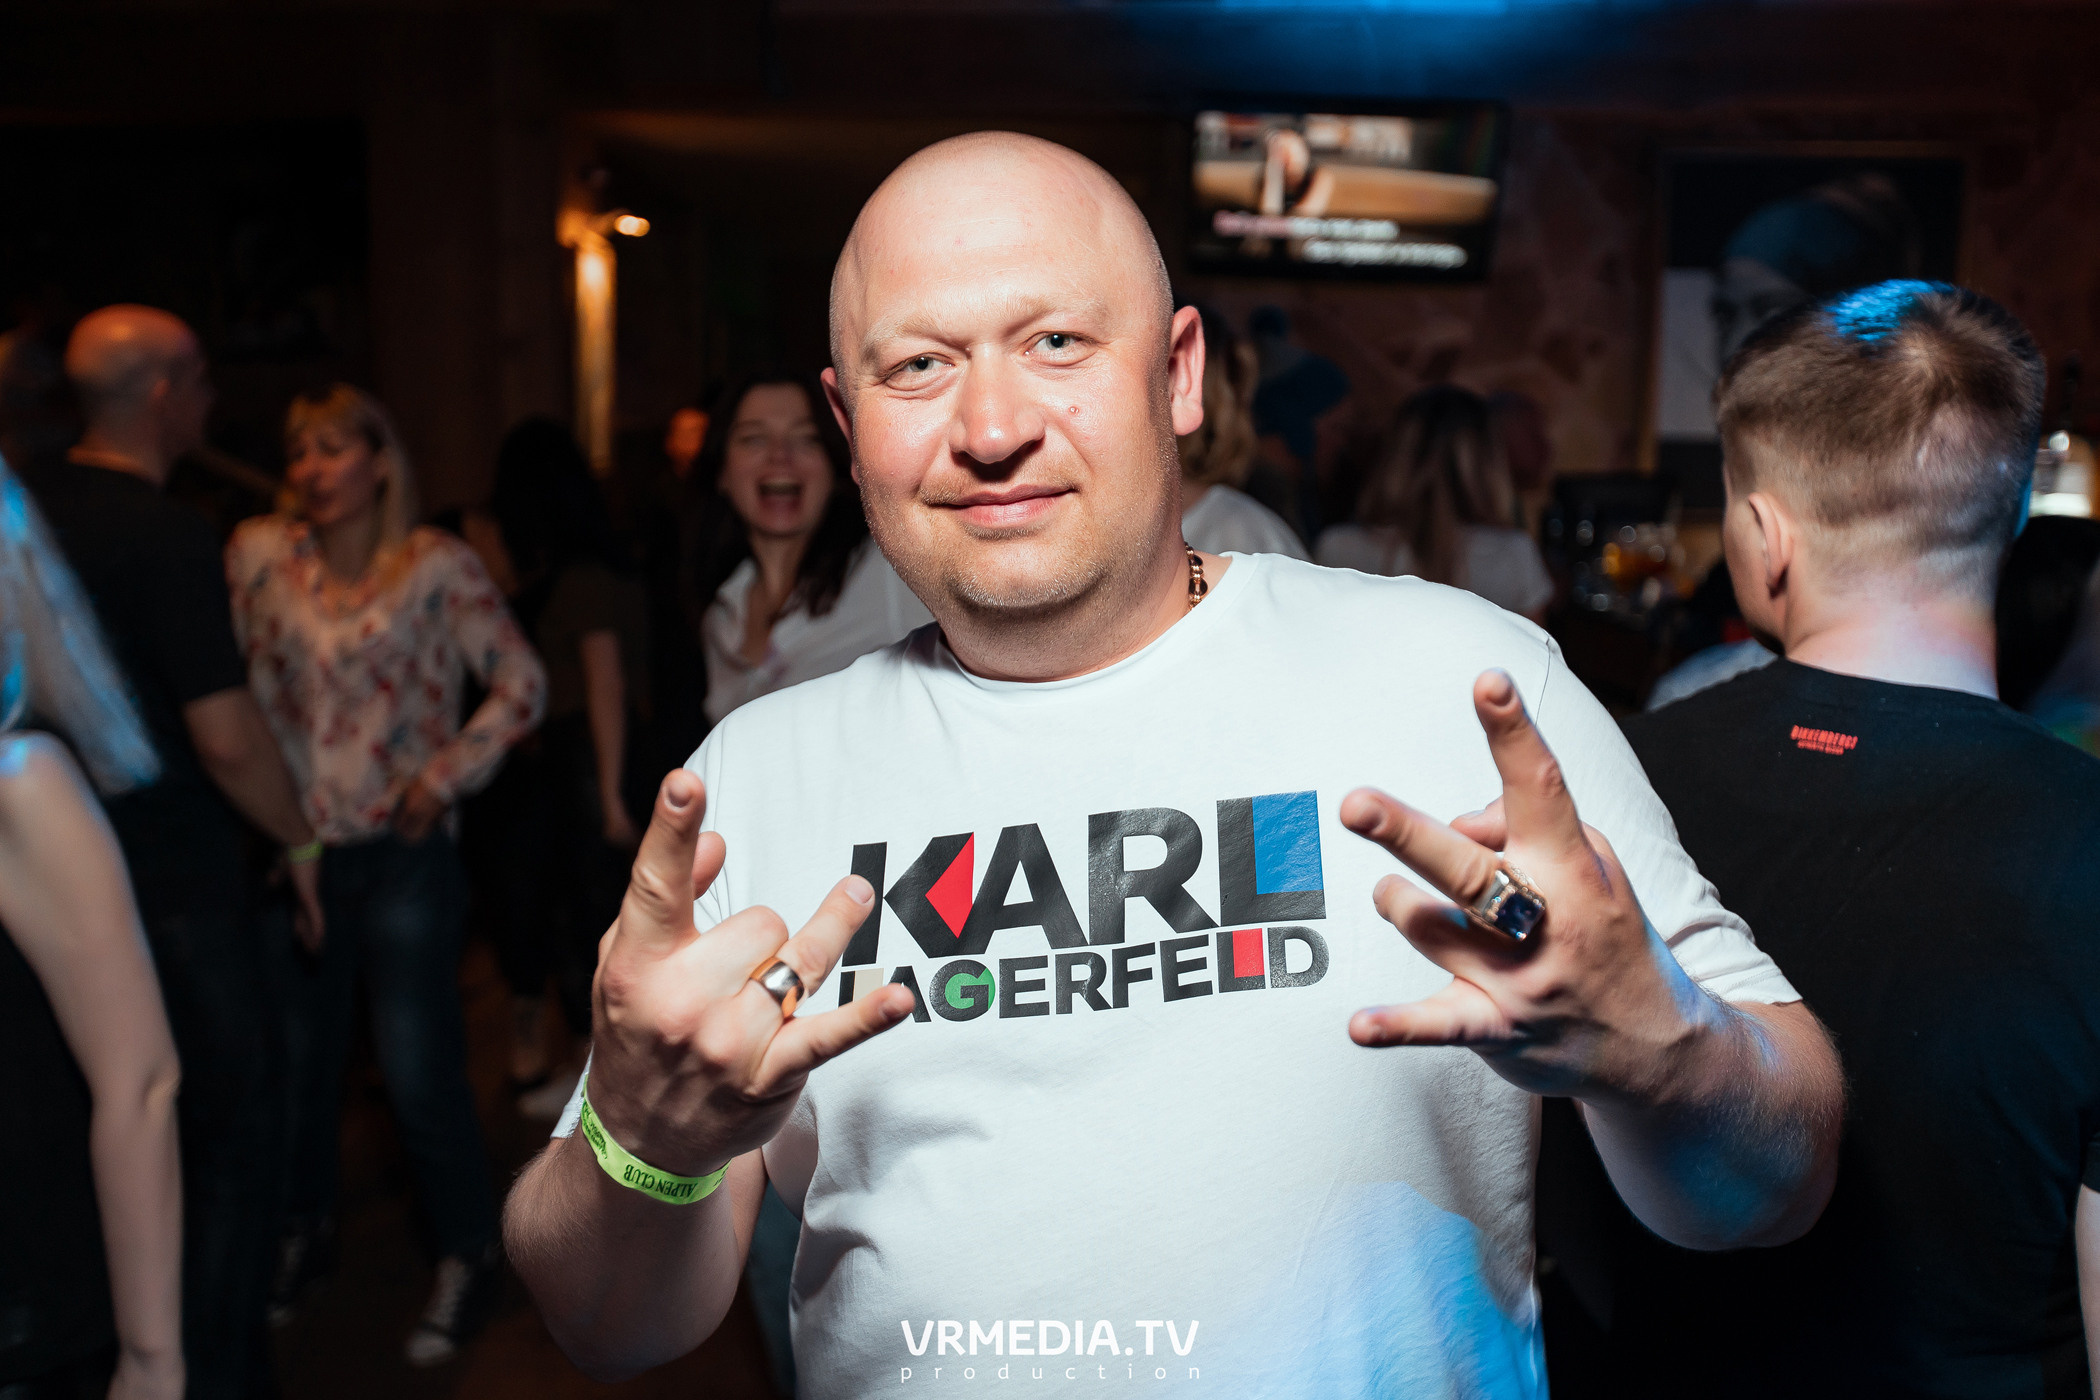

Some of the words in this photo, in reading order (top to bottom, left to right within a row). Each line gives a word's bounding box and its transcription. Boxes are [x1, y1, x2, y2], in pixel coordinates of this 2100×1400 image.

[841, 790, 1326, 967] KARL
[623, 1163, 656, 1189] CLUB
[656, 1179, 699, 1198] ALPEN
